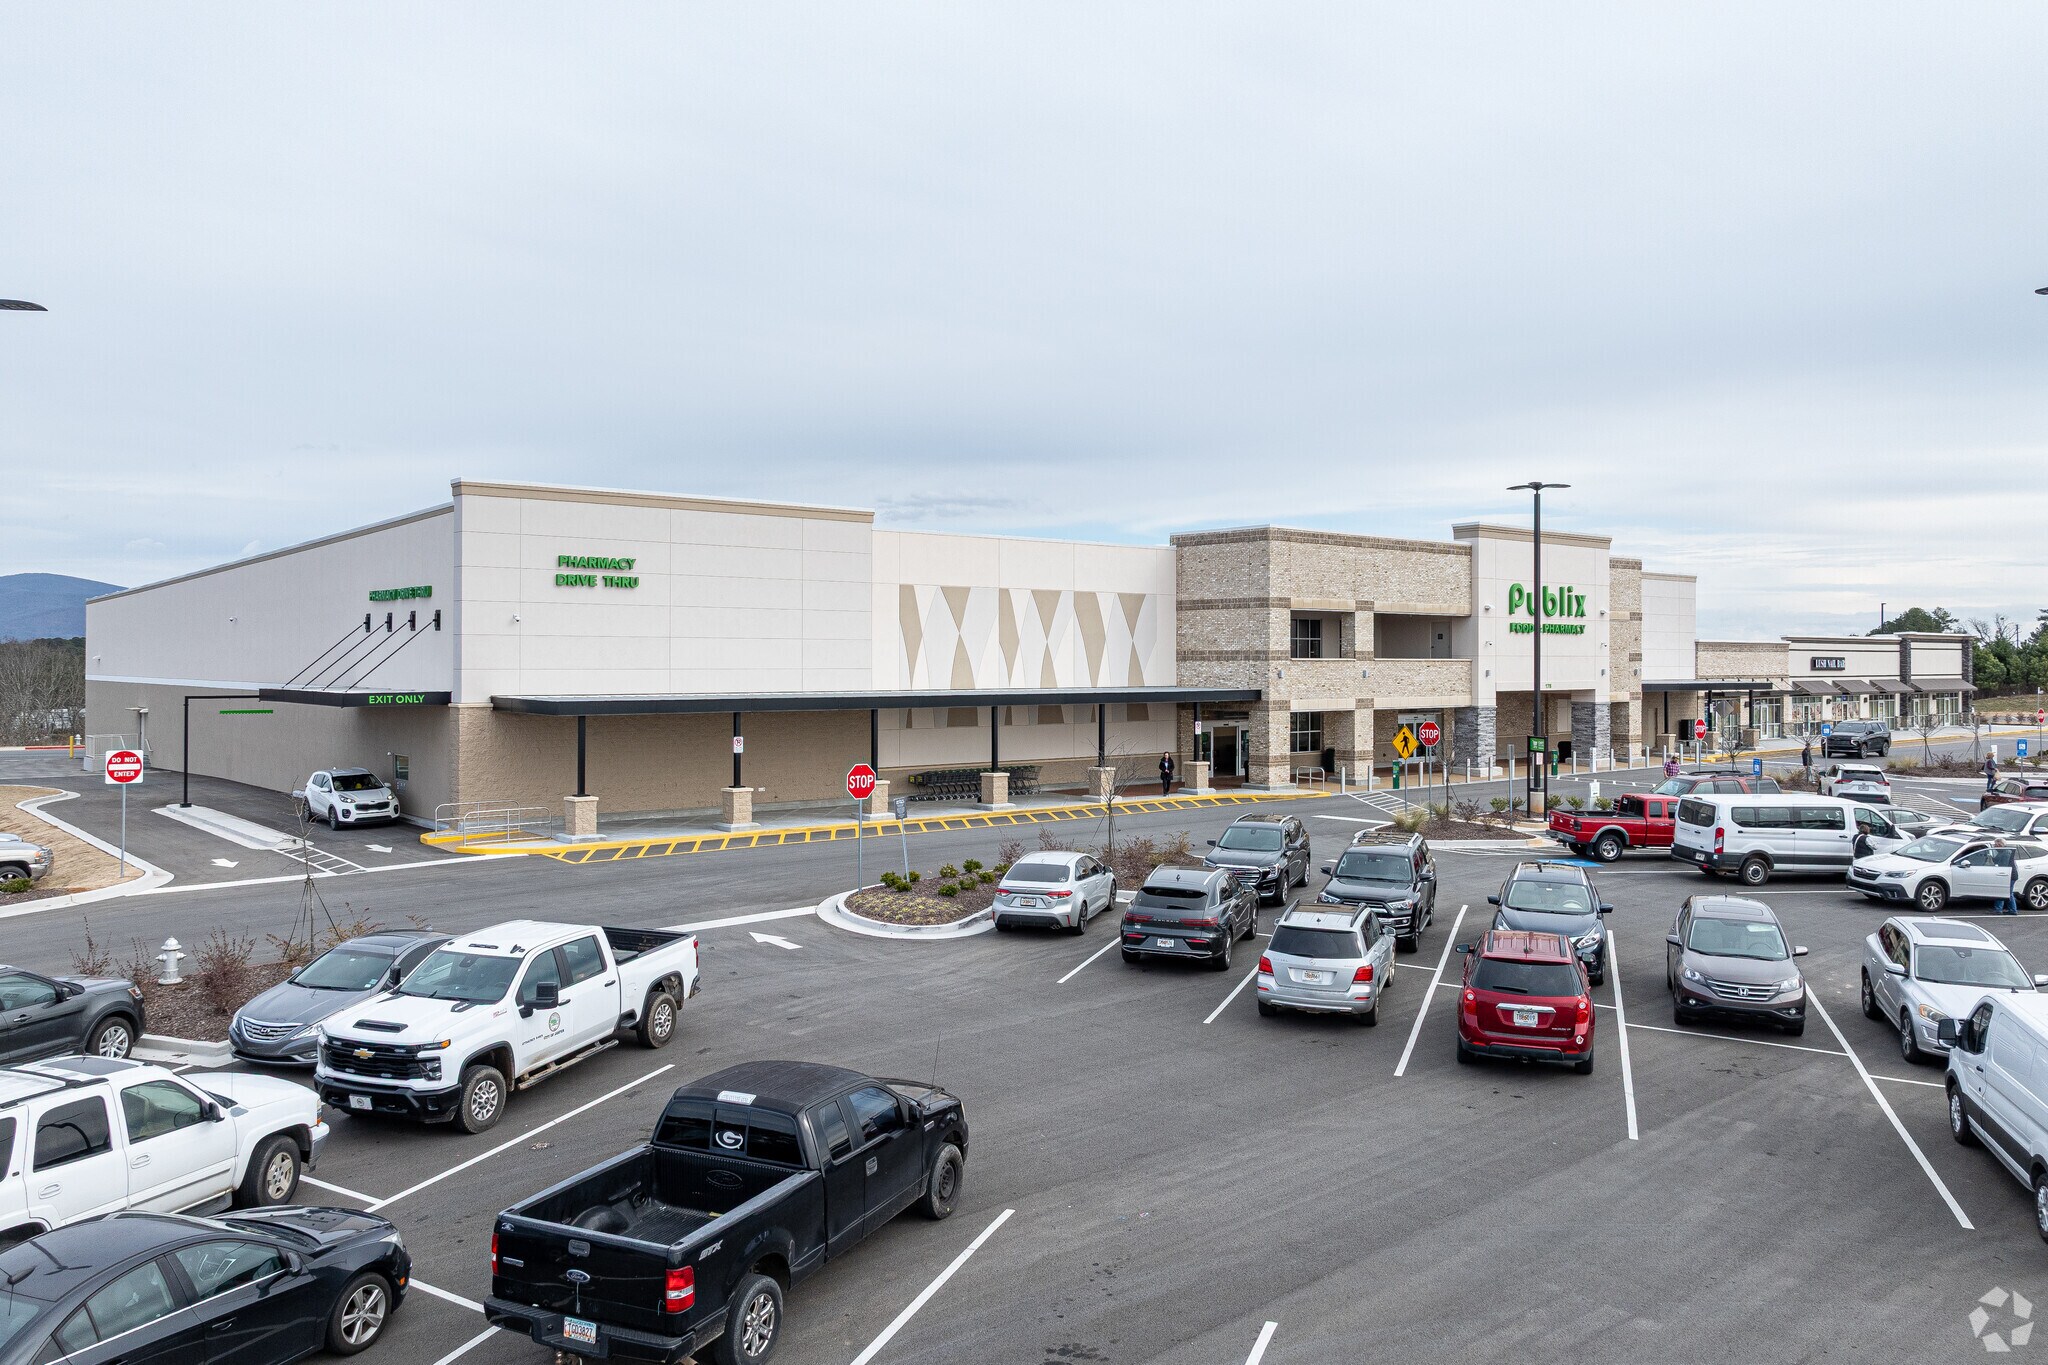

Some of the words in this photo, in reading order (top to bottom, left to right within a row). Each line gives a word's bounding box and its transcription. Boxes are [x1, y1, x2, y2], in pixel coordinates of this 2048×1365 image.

[558, 555, 636, 570] PHARMACY
[556, 574, 597, 587] DRIVE
[602, 576, 639, 588] THRU
[1509, 583, 1586, 617] Publix
[1509, 622, 1534, 633] FOOD
[1543, 623, 1586, 635] PHARMACY
[369, 695, 393, 704] EXIT
[395, 694, 425, 704] ONLY
[1420, 729, 1438, 739] STOP
[1695, 725, 1706, 733] STOP
[849, 774, 873, 789] STOP
[571, 1272, 586, 1281] Ford
